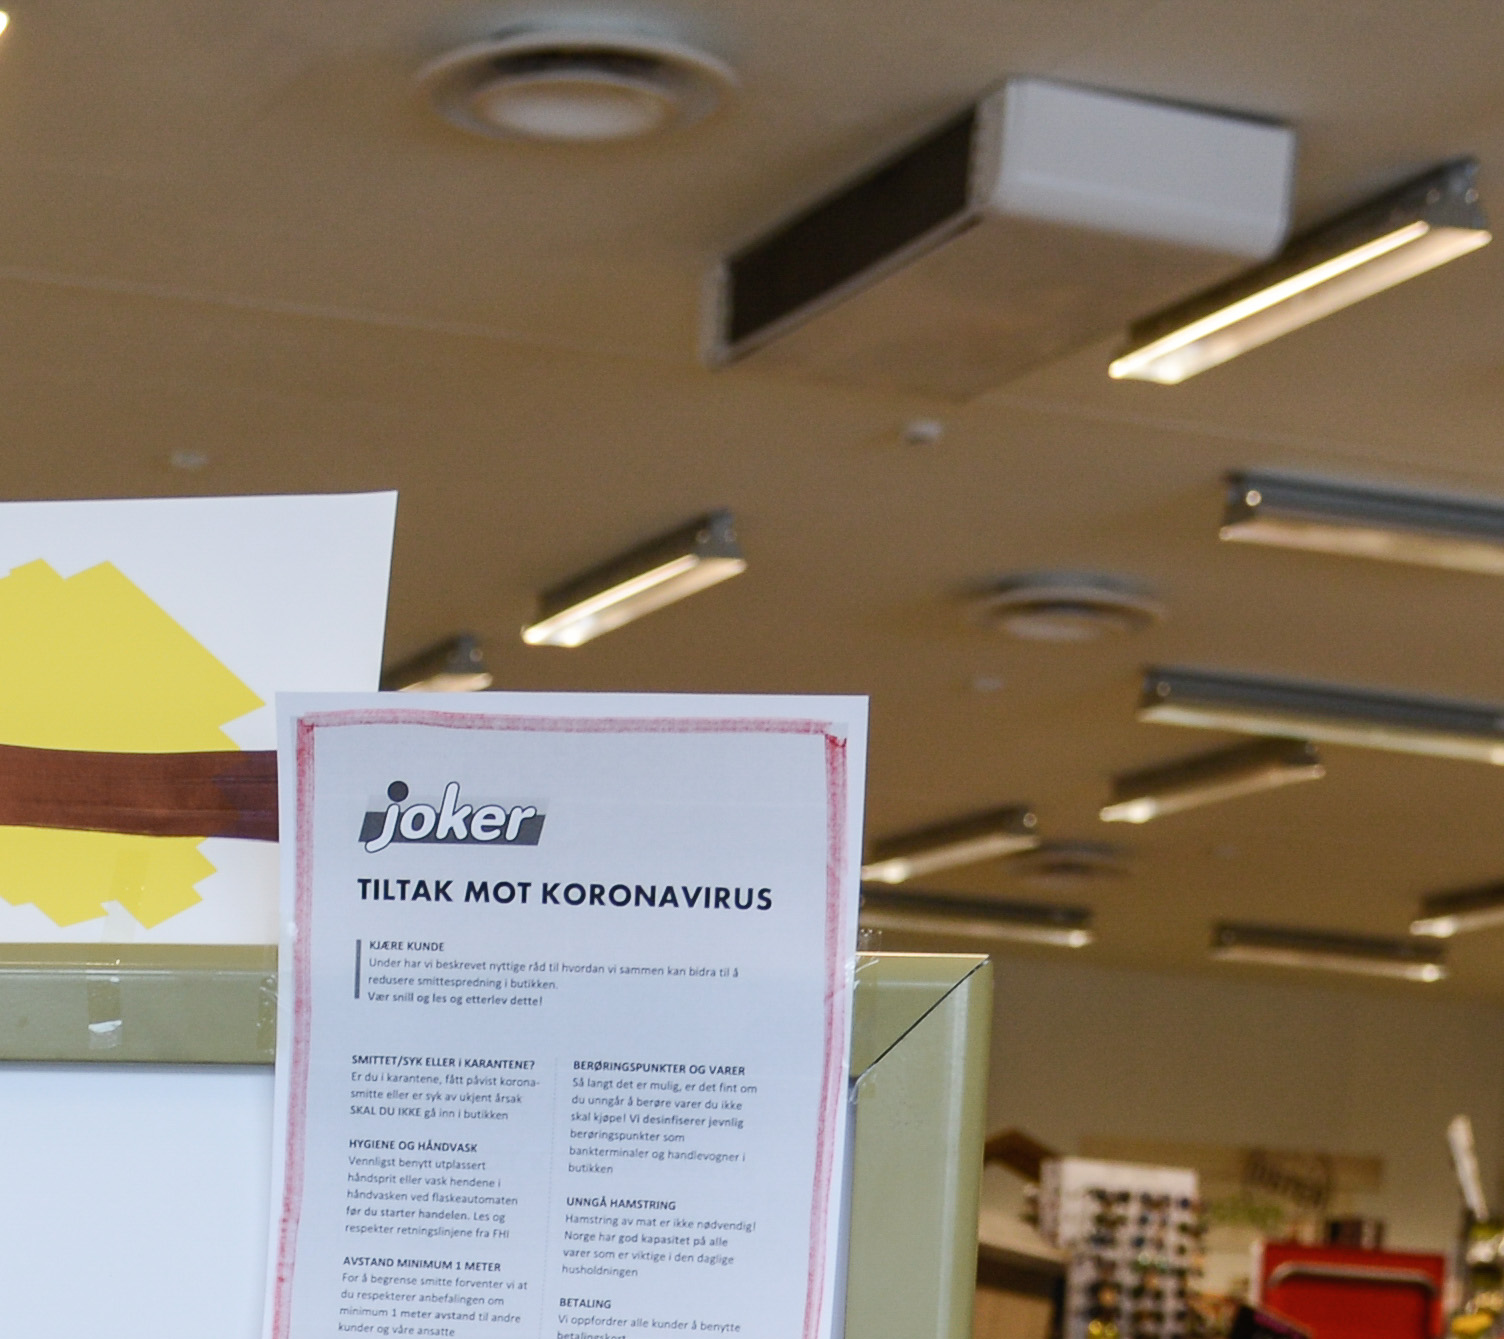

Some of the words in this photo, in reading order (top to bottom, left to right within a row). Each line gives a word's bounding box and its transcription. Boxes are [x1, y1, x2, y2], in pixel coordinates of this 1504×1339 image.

[365, 781, 539, 853] joker
[357, 878, 454, 903] TILTAK
[464, 880, 533, 904] MOT
[542, 882, 773, 911] KORONAVIRUS
[369, 941, 404, 951] KJÆRE
[407, 942, 445, 952] KUNDE
[369, 958, 402, 968] Under
[404, 958, 422, 969] har
[424, 960, 434, 969] vi
[435, 959, 487, 971] beskrevet
[489, 961, 527, 974] nyttige
[528, 961, 547, 972] råd
[549, 962, 560, 973] til
[561, 962, 606, 974] hvordan
[607, 964, 618, 975] vi
[619, 966, 665, 976] sammen
[667, 966, 687, 976] kan
[689, 966, 717, 978] bidra
[719, 967, 731, 978] til
[368, 975, 416, 986] redusere
[417, 976, 503, 991] smittespredning
[510, 978, 558, 990] butikken.
[367, 991, 391, 1002] Vær
[393, 992, 415, 1002] snill
[416, 995, 431, 1005] og
[432, 993, 448, 1004] les
[449, 996, 464, 1006] og
[465, 995, 509, 1005] etterlev
[510, 995, 544, 1007] dette!
[352, 1054, 424, 1068] SMITTET/SYK
[425, 1057, 456, 1068] ELLER
[464, 1059, 536, 1070] KARANTENE?
[573, 1060, 687, 1074] BERØRINGSPUNKTER
[689, 1064, 707, 1075] OG
[709, 1065, 746, 1076] VARER
[351, 1071, 363, 1082] Er
[364, 1072, 380, 1082] du
[386, 1072, 443, 1086] karantene,
[445, 1074, 464, 1085] fått
[466, 1075, 498, 1087] påvist
[500, 1076, 541, 1088] korona-
[572, 1077, 585, 1088] Så
[587, 1078, 614, 1091] langt
[616, 1079, 635, 1090] det
[636, 1082, 649, 1090] er
[650, 1080, 683, 1094] mulig,
[685, 1084, 697, 1092] er
[698, 1082, 717, 1093] det
[719, 1082, 738, 1093] fint
[740, 1085, 758, 1094] om
[350, 1090, 385, 1100] smitte
[386, 1089, 410, 1100] eller
[412, 1092, 424, 1101] er
[425, 1091, 443, 1103] syk
[444, 1094, 458, 1102] av
[459, 1092, 493, 1105] ukjent
[495, 1093, 523, 1104] årsak
[571, 1094, 586, 1105] du
[588, 1095, 626, 1109] unngår
[636, 1097, 673, 1109] berøre
[674, 1100, 703, 1110] varer
[704, 1099, 719, 1110] du
[721, 1100, 743, 1111] ikke
[350, 1105, 377, 1116] SKAL
[379, 1106, 396, 1117] DU
[398, 1107, 422, 1117] IKKE
[424, 1107, 437, 1120] gå
[439, 1108, 456, 1118] inn
[463, 1109, 509, 1120] butikken
[571, 1111, 592, 1122] skal
[593, 1112, 627, 1125] kjøpe!
[629, 1114, 641, 1124] Vi
[642, 1114, 707, 1127] desinfiserer
[708, 1116, 745, 1130] jevnlig
[570, 1129, 661, 1143] berøringspunkter
[663, 1134, 686, 1143] som
[349, 1139, 396, 1150] HYGIENE
[398, 1140, 416, 1151] OG
[418, 1139, 478, 1153] HÅNDVASK
[348, 1156, 397, 1169] Vennligst
[398, 1157, 433, 1170] benytt
[435, 1159, 487, 1171] utplassert
[347, 1188, 409, 1201] håndvasken
[410, 1192, 430, 1202] ved
[432, 1192, 519, 1206] flaskeautomaten
[566, 1195, 608, 1208] UNNGÅ
[610, 1199, 677, 1211] HAMSTRING
[345, 1224, 395, 1235] respekter
[397, 1226, 474, 1239] retningslinjene
[475, 1227, 491, 1239] fra
[492, 1229, 511, 1239] FHI
[343, 1256, 395, 1268] AVSTAND
[397, 1259, 454, 1270] MINIMUM
[464, 1261, 502, 1272] METER
[559, 1297, 612, 1310] BETALING
